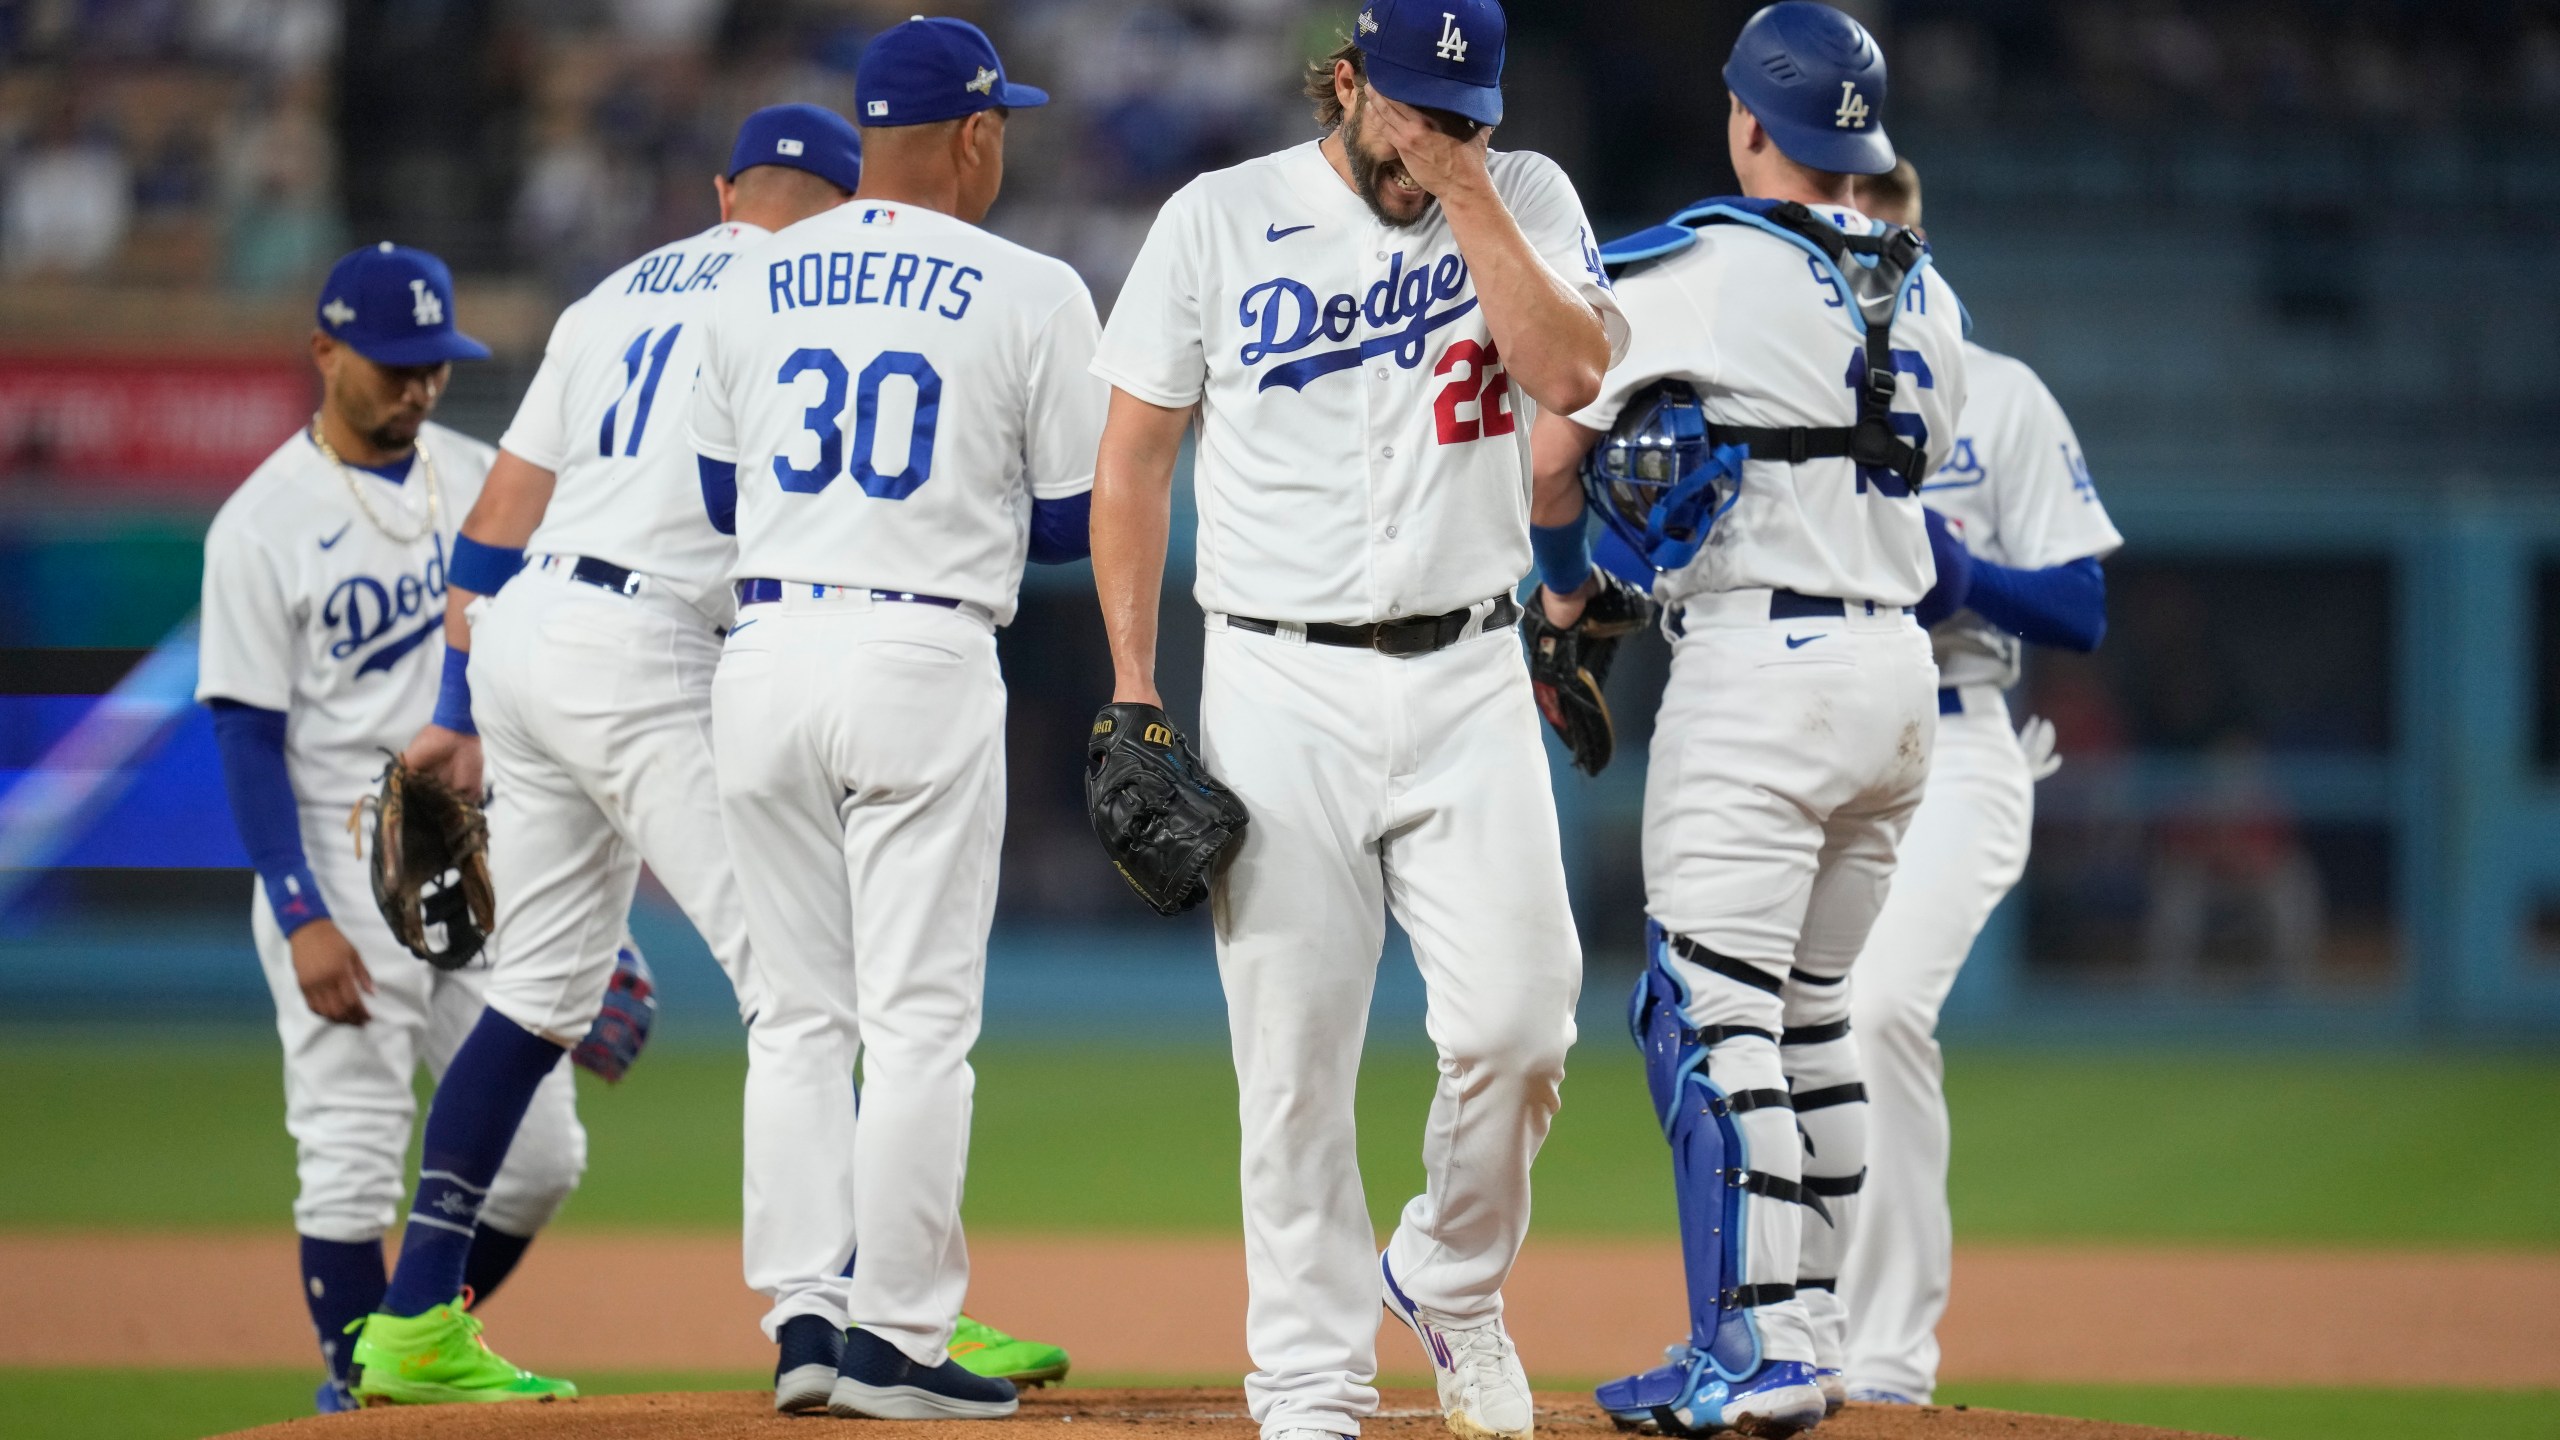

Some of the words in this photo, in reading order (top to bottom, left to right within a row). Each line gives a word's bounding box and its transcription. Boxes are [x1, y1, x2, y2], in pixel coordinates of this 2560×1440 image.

[1437, 12, 1468, 62] LA
[1836, 81, 1869, 128] LA
[409, 279, 443, 326] LA
[625, 253, 741, 294] ROJA
[769, 252, 983, 321] ROBERTS
[1239, 251, 1470, 369] Dodge
[599, 323, 683, 457] 11
[773, 348, 943, 501] 30
[1433, 339, 1516, 445] 22
[1845, 347, 1934, 498] 16
